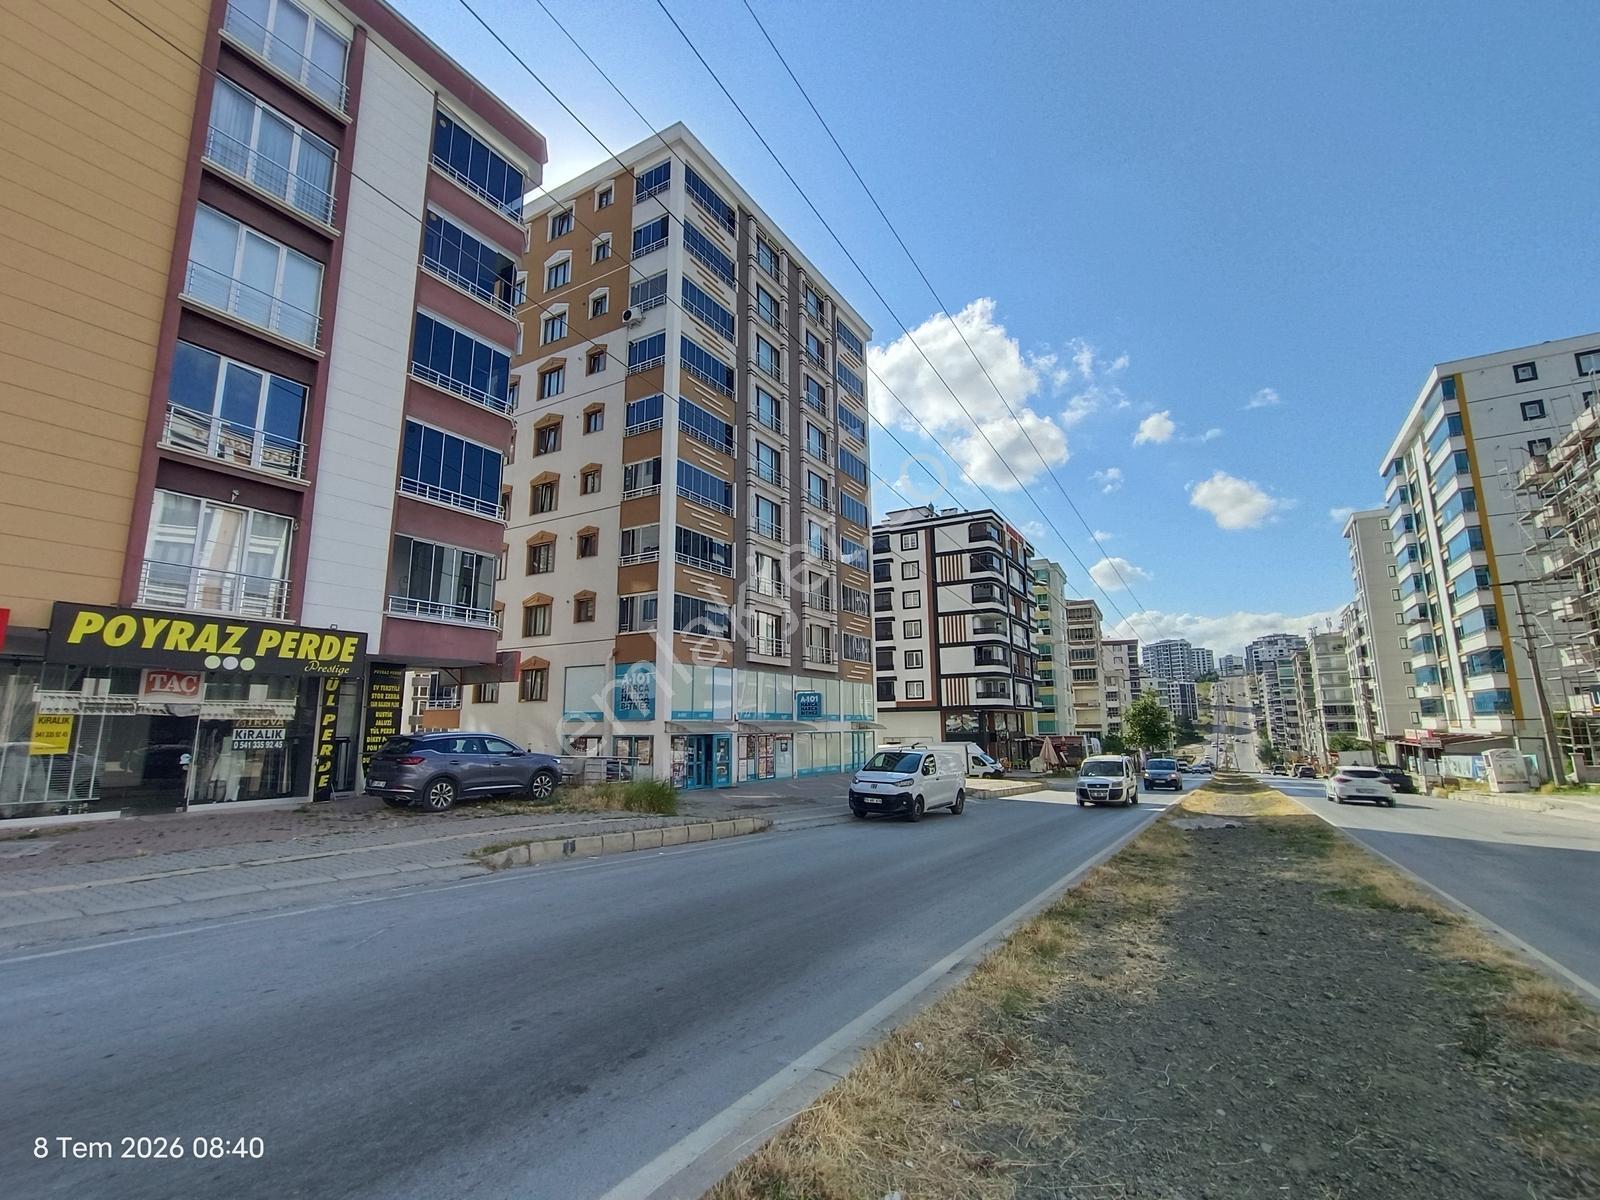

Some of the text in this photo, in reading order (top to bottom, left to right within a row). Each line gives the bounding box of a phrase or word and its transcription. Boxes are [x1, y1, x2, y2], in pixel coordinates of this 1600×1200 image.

[67, 611, 358, 662] POYRAZ PERDE
[304, 660, 350, 676] Prestige
[149, 674, 198, 696] TAÇ
[233, 741, 283, 749] 0 541 335 92 45
